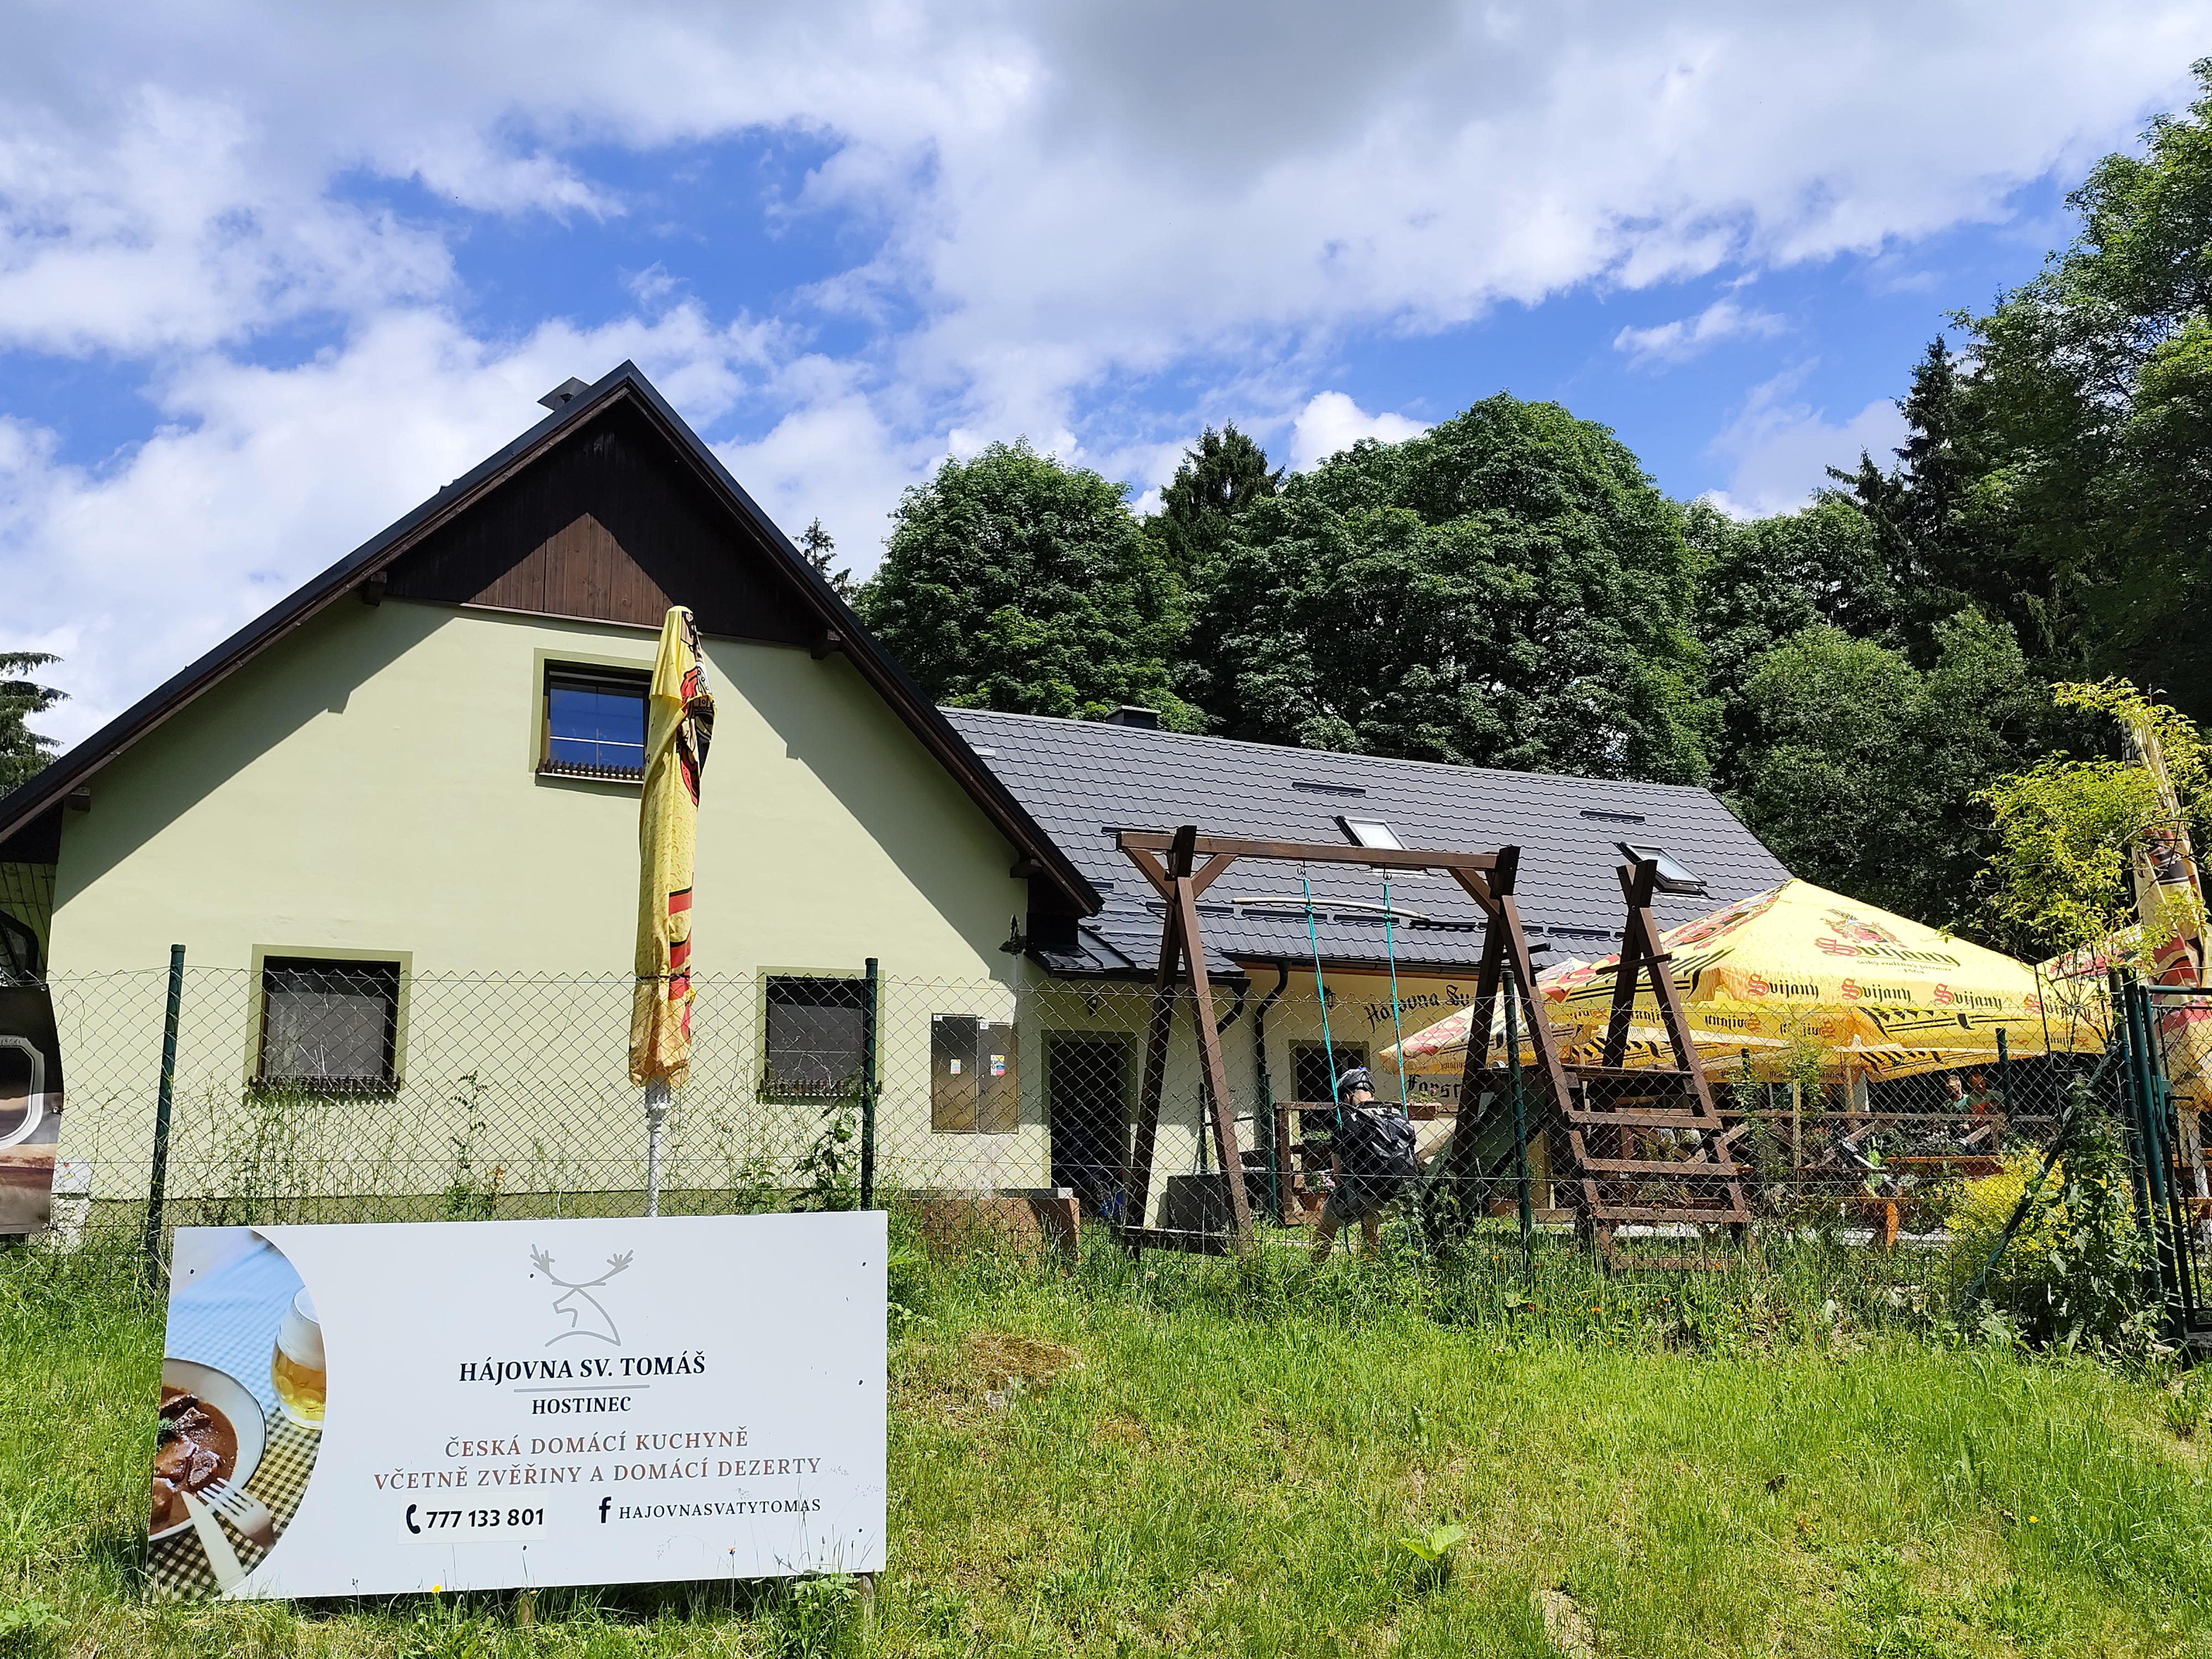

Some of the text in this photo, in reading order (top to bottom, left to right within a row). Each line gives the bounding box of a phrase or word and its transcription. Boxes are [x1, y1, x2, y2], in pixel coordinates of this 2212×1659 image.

[1814, 937, 1960, 967] Svijany
[1748, 973, 2002, 1011] Svijany Svijany Svijany
[460, 1350, 705, 1386] HÁJOVNA SV. TOMÁŠ
[532, 1396, 631, 1415] HOSTINEC
[445, 1425, 748, 1457] ČESKÁ DOMÁCÍ KUCHYNĚ
[374, 1457, 821, 1490] VČETNĚ ZVĚŘINY A DOMÁCÍ DEZERTY
[426, 1508, 544, 1528] 777 133 801
[619, 1499, 821, 1519] HAJOVNASVATYTOMAS
